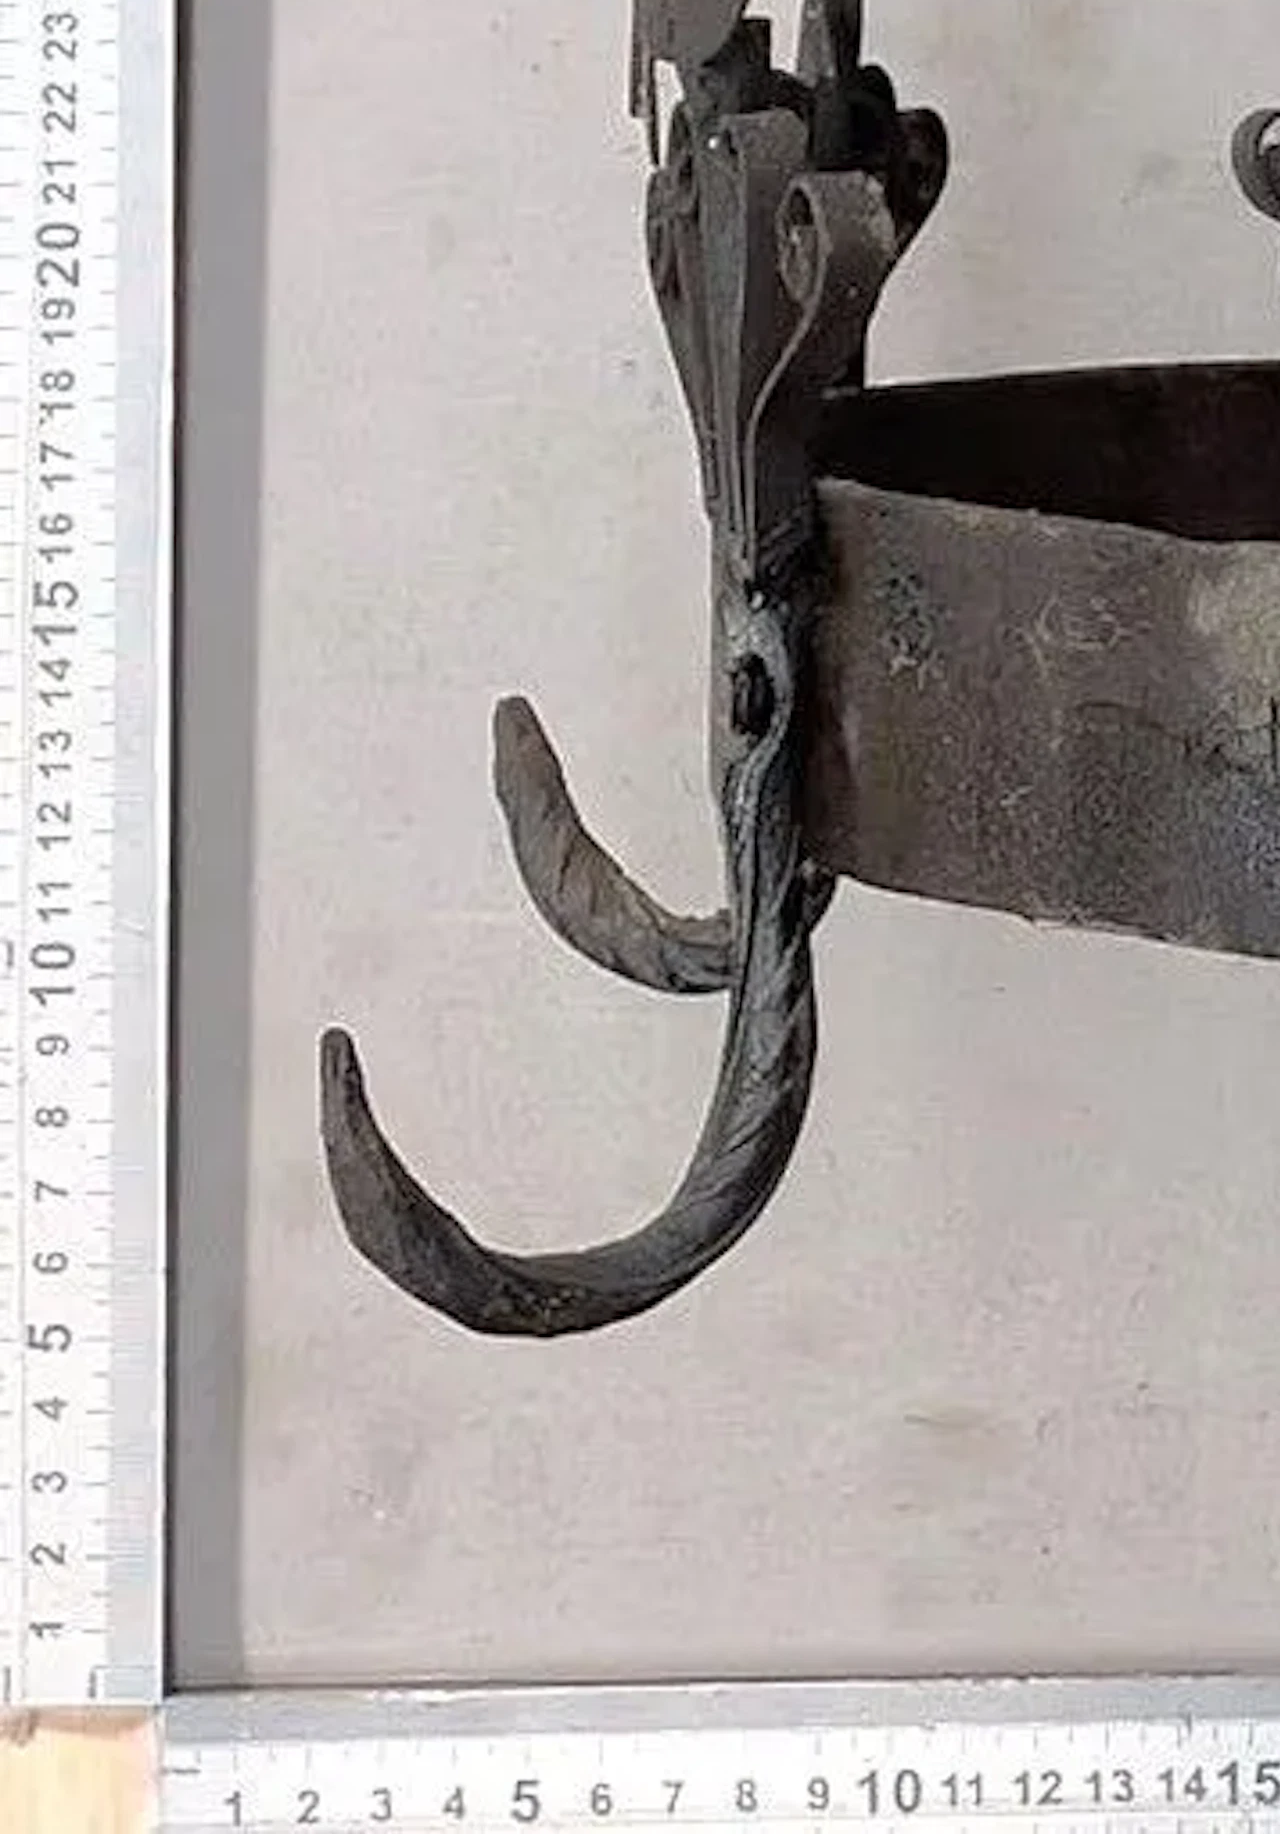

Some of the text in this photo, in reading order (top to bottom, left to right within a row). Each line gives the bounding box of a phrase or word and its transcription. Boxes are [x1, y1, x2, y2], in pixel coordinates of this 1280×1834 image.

[43, 11, 77, 60] 23
[42, 82, 77, 133] 22
[42, 158, 77, 204] 21
[35, 223, 80, 288] 20
[41, 297, 76, 345] 19
[41, 369, 75, 417] 18
[41, 442, 75, 490] 17
[39, 511, 74, 561] 16
[34, 578, 79, 642] 15
[39, 658, 73, 706] 14
[38, 728, 73, 778] 13
[38, 800, 73, 850] 12
[37, 878, 70, 922] 11
[30, 942, 74, 1006] 10
[37, 1032, 70, 1056] 9
[36, 1105, 68, 1128] 8
[36, 1178, 68, 1200] 7
[35, 1250, 67, 1274] 6
[29, 1322, 71, 1352] 5
[34, 1396, 67, 1420] 4
[34, 1469, 66, 1493] 3
[34, 1541, 67, 1565] 2
[29, 1620, 64, 1638] 1
[224, 1791, 242, 1826] 1
[297, 1791, 321, 1826] 2
[370, 1789, 393, 1822] 3
[441, 1787, 466, 1821] 4
[511, 1780, 541, 1823] 5
[589, 1784, 614, 1817] 6
[662, 1782, 684, 1816] 7
[735, 1780, 759, 1814] 8
[807, 1779, 830, 1812] 9
[858, 1770, 922, 1816] 10
[940, 1773, 983, 1808] 11
[1014, 1770, 1063, 1805] 12
[1084, 1768, 1134, 1804] 13
[1159, 1766, 1208, 1802] 14
